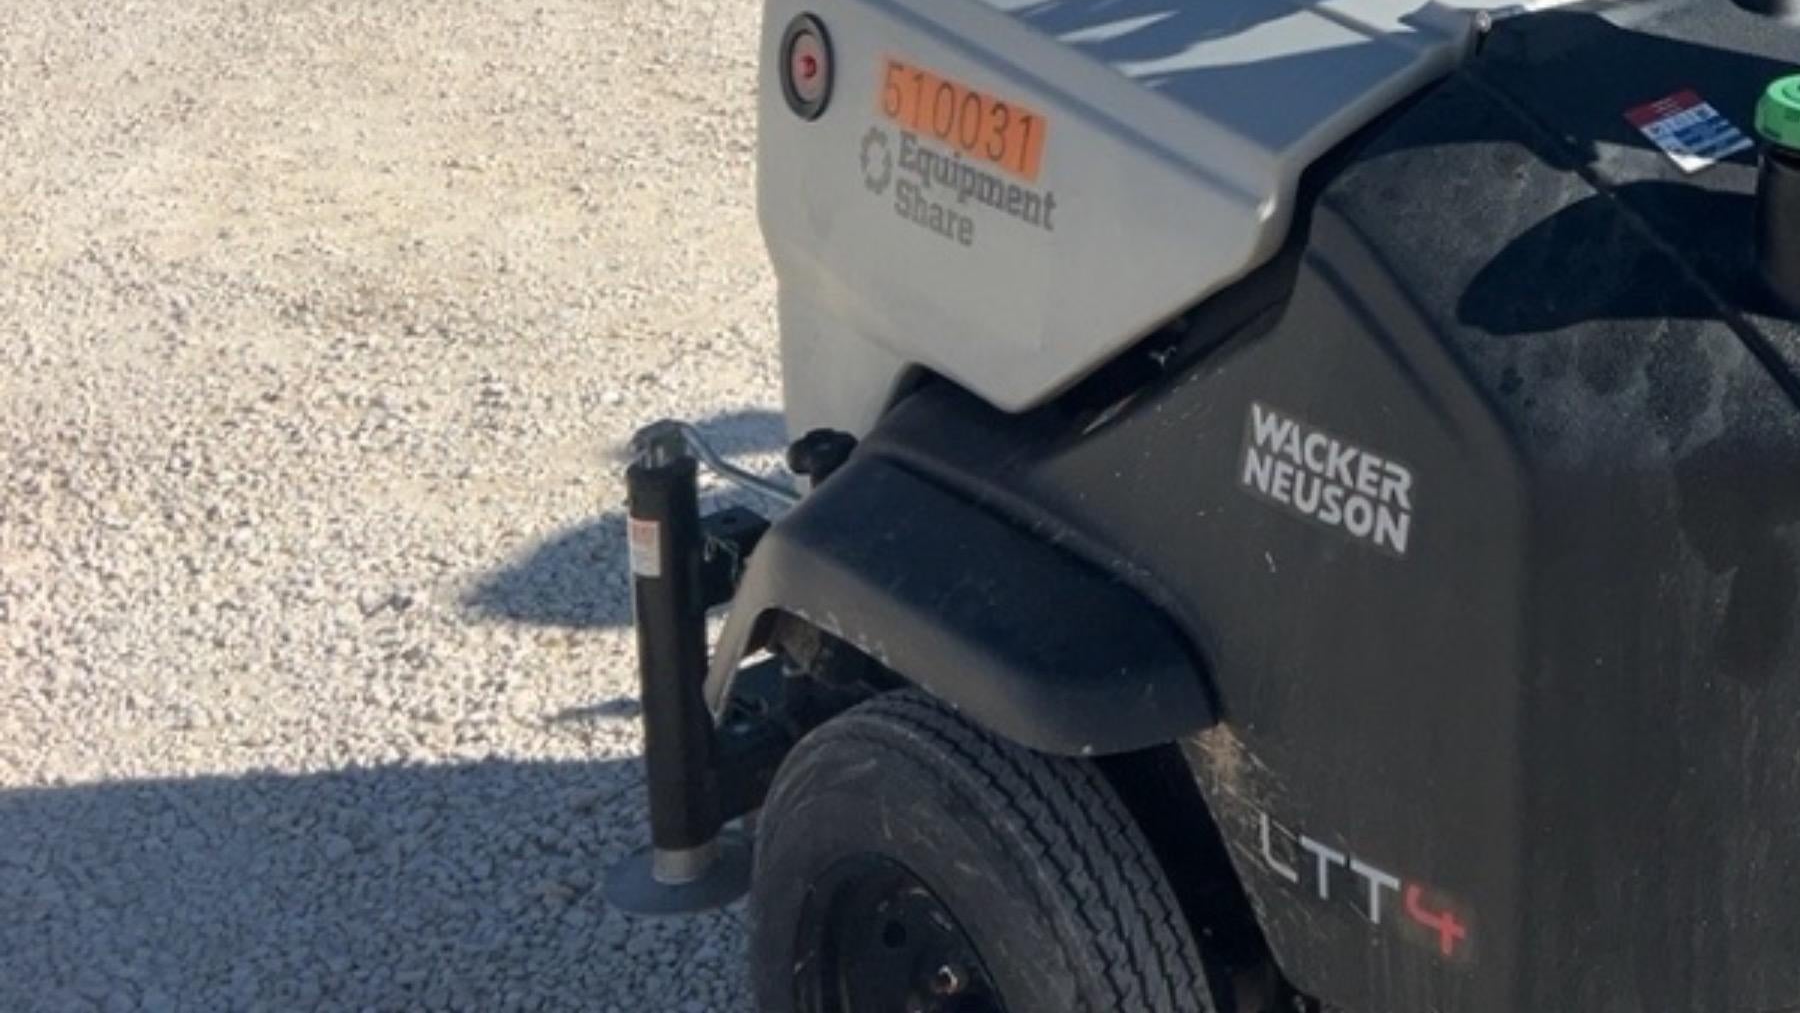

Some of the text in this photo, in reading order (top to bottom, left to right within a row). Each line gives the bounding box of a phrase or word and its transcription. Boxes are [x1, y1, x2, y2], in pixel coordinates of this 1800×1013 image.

[893, 179, 975, 247] Share
[898, 131, 1057, 231] Equipment
[1243, 447, 1412, 554] NEUSON
[1252, 402, 1413, 511] WACKER
[1259, 812, 1466, 955] LTT4
